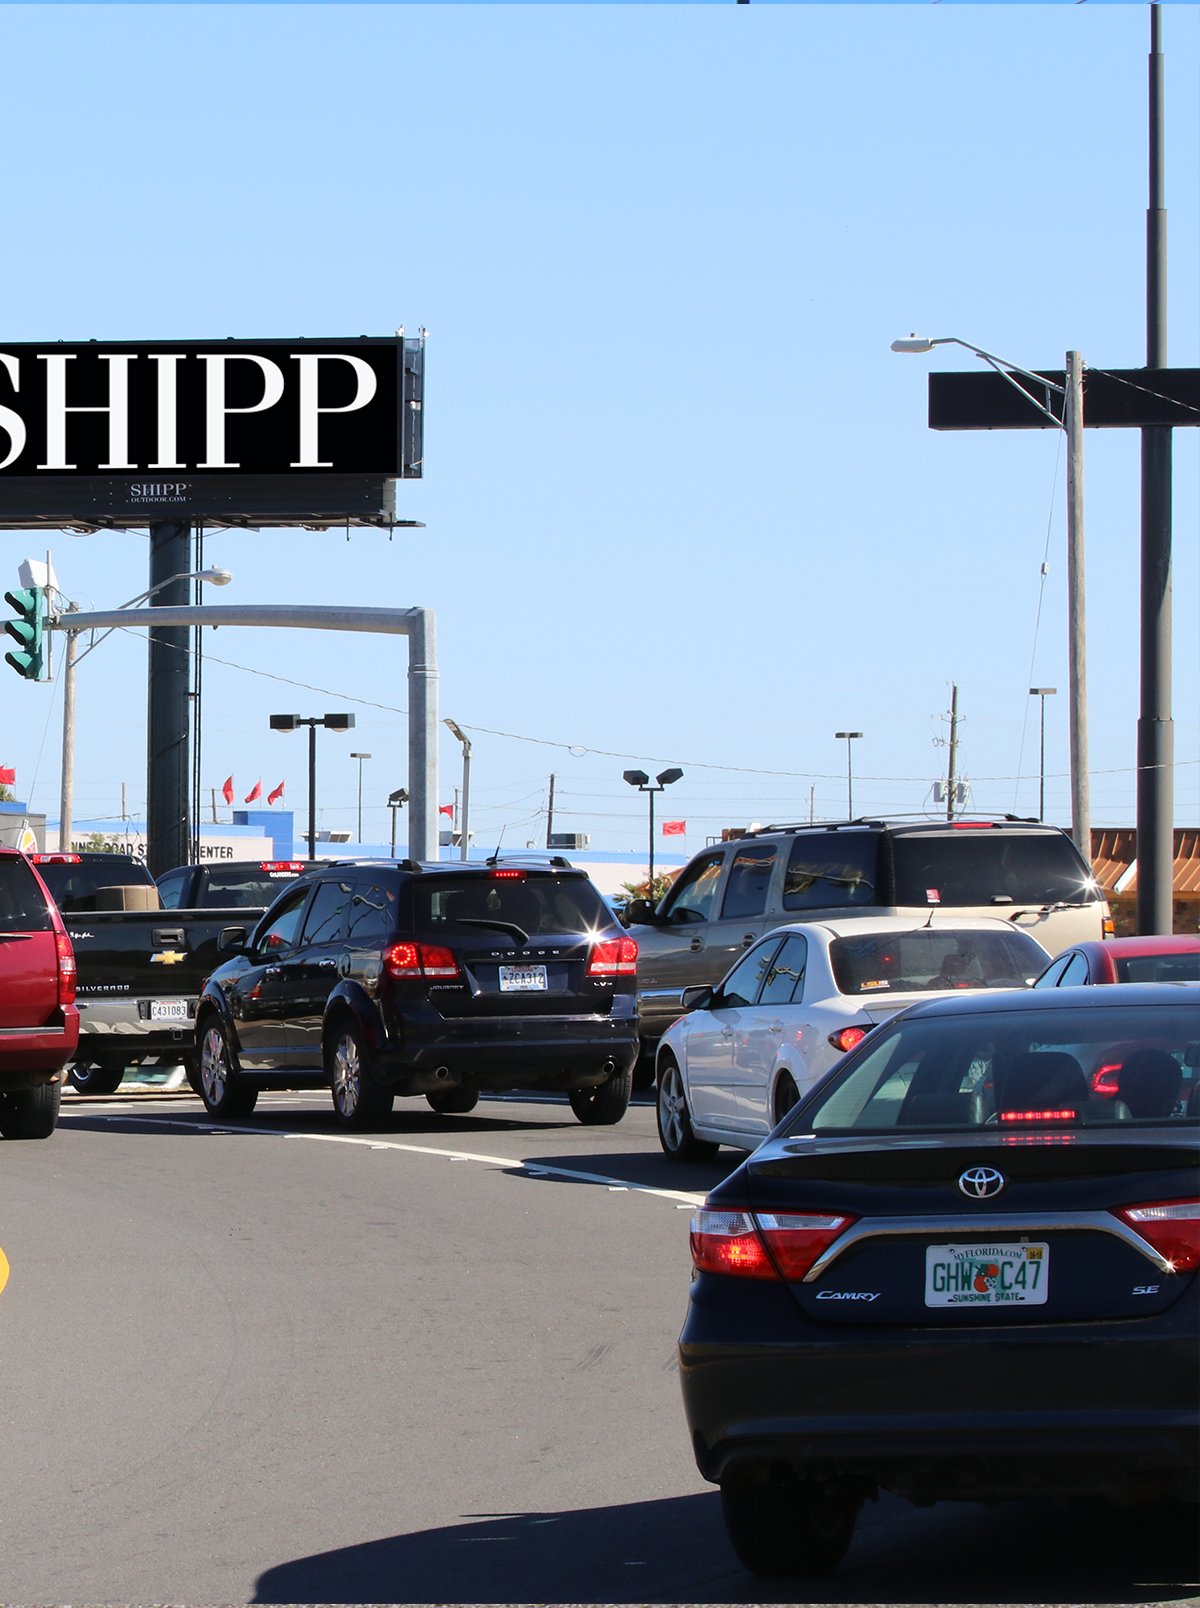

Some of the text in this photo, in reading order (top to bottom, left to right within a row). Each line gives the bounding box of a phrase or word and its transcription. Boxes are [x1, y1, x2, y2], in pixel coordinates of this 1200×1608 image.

[130, 483, 187, 496] SHIPP
[193, 845, 233, 858] ENTER
[509, 972, 544, 985] ZCA312
[152, 1006, 187, 1016] C431083
[953, 1247, 1022, 1260] MYFLORIDA.COM
[933, 1261, 1041, 1292] GHW C47
[816, 1290, 881, 1301] CAMRY
[1132, 1285, 1160, 1294] SE
[953, 1293, 1020, 1302] SUNSHINE STATE
